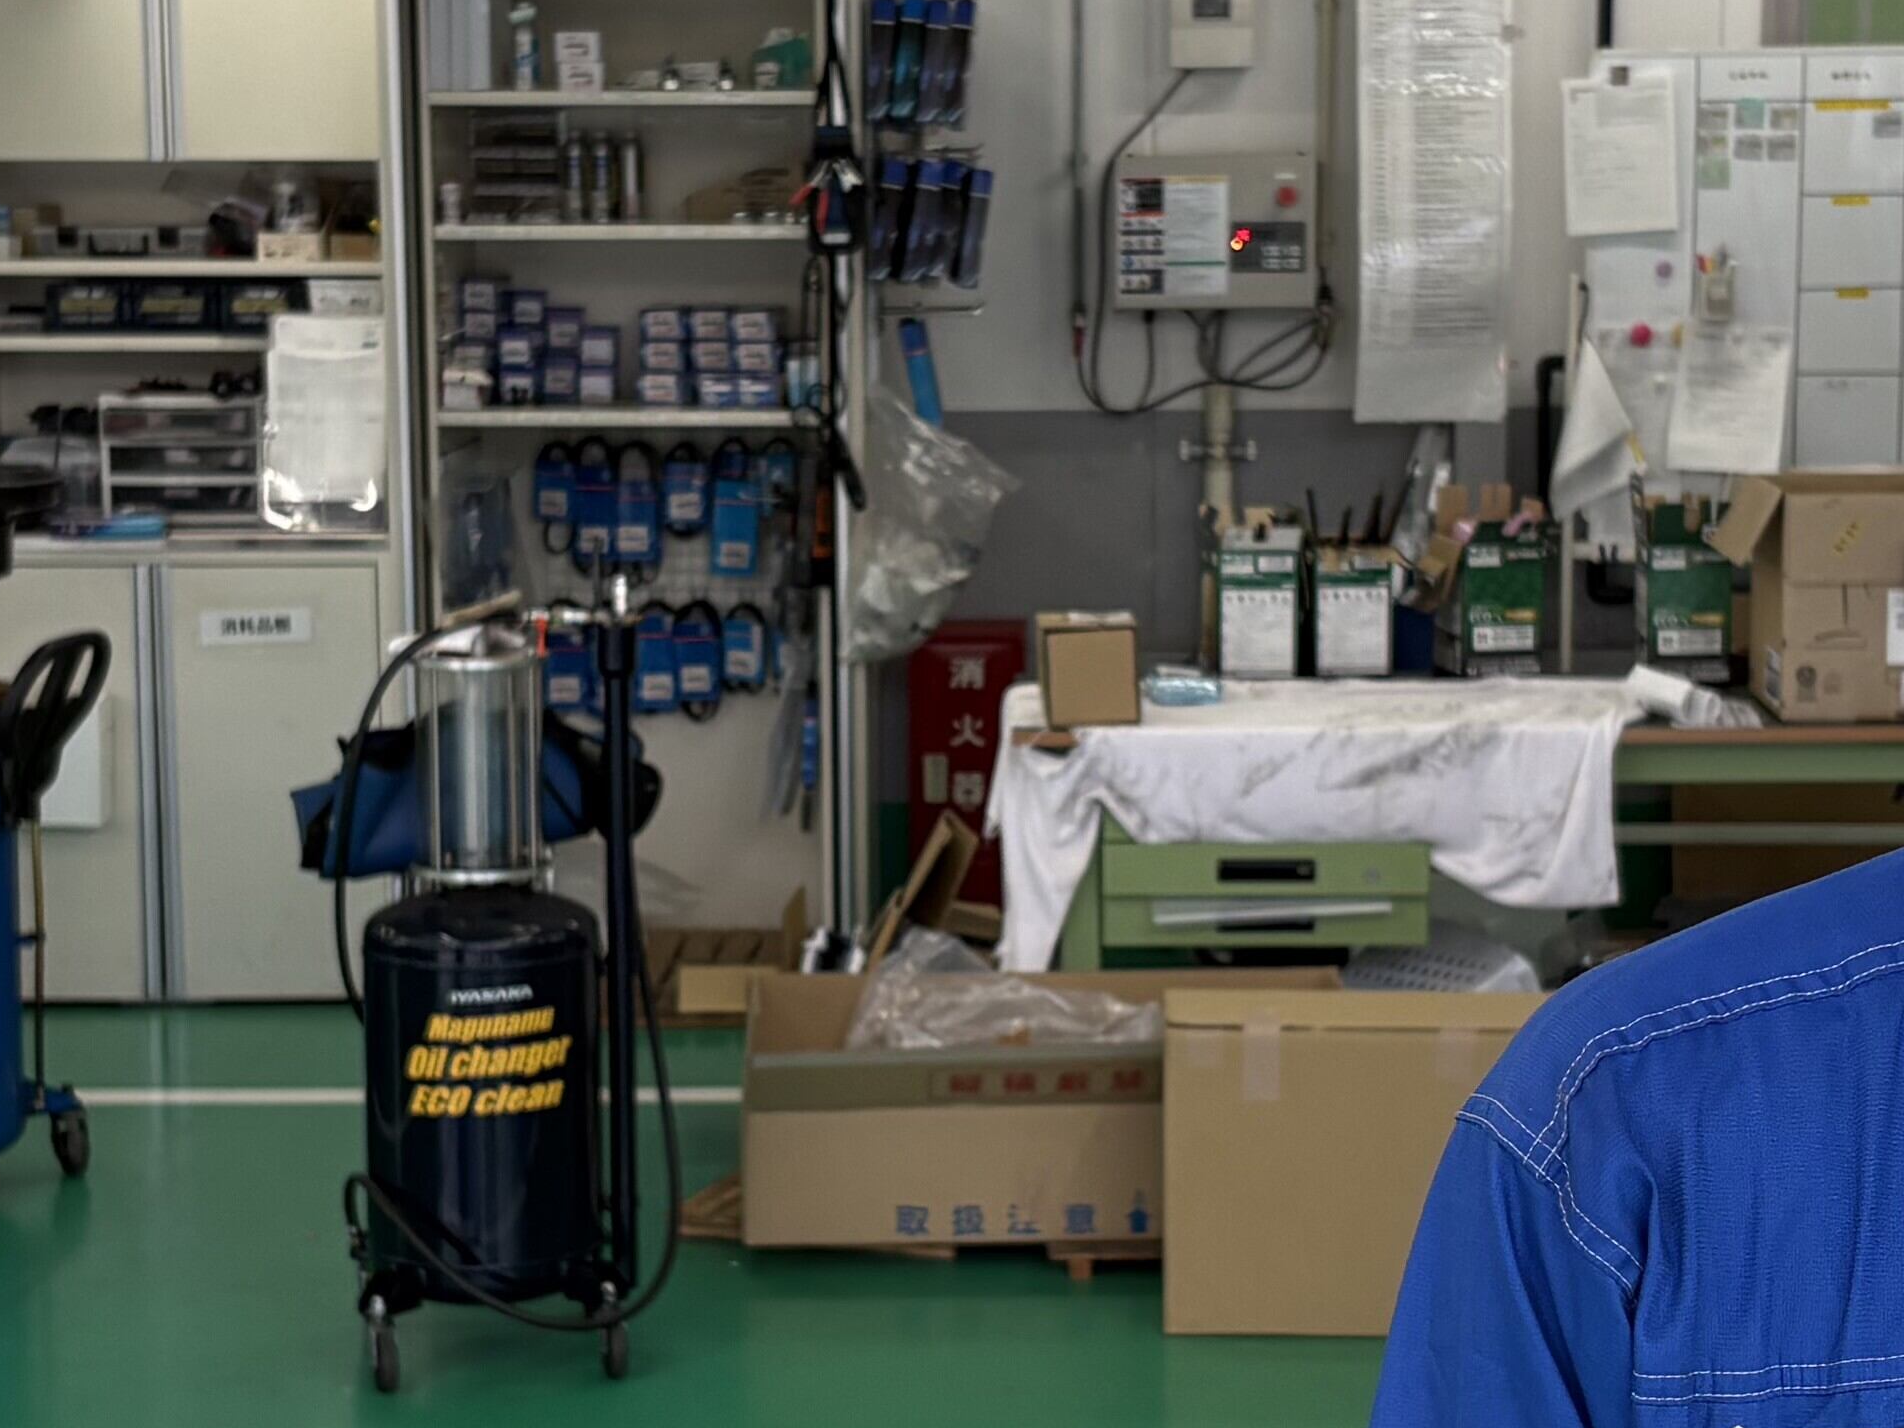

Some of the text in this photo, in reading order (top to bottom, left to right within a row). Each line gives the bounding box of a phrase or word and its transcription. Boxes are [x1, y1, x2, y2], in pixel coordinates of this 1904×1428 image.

[407, 1035, 573, 1080] Oil changer
[411, 1078, 565, 1117] ECO clean
